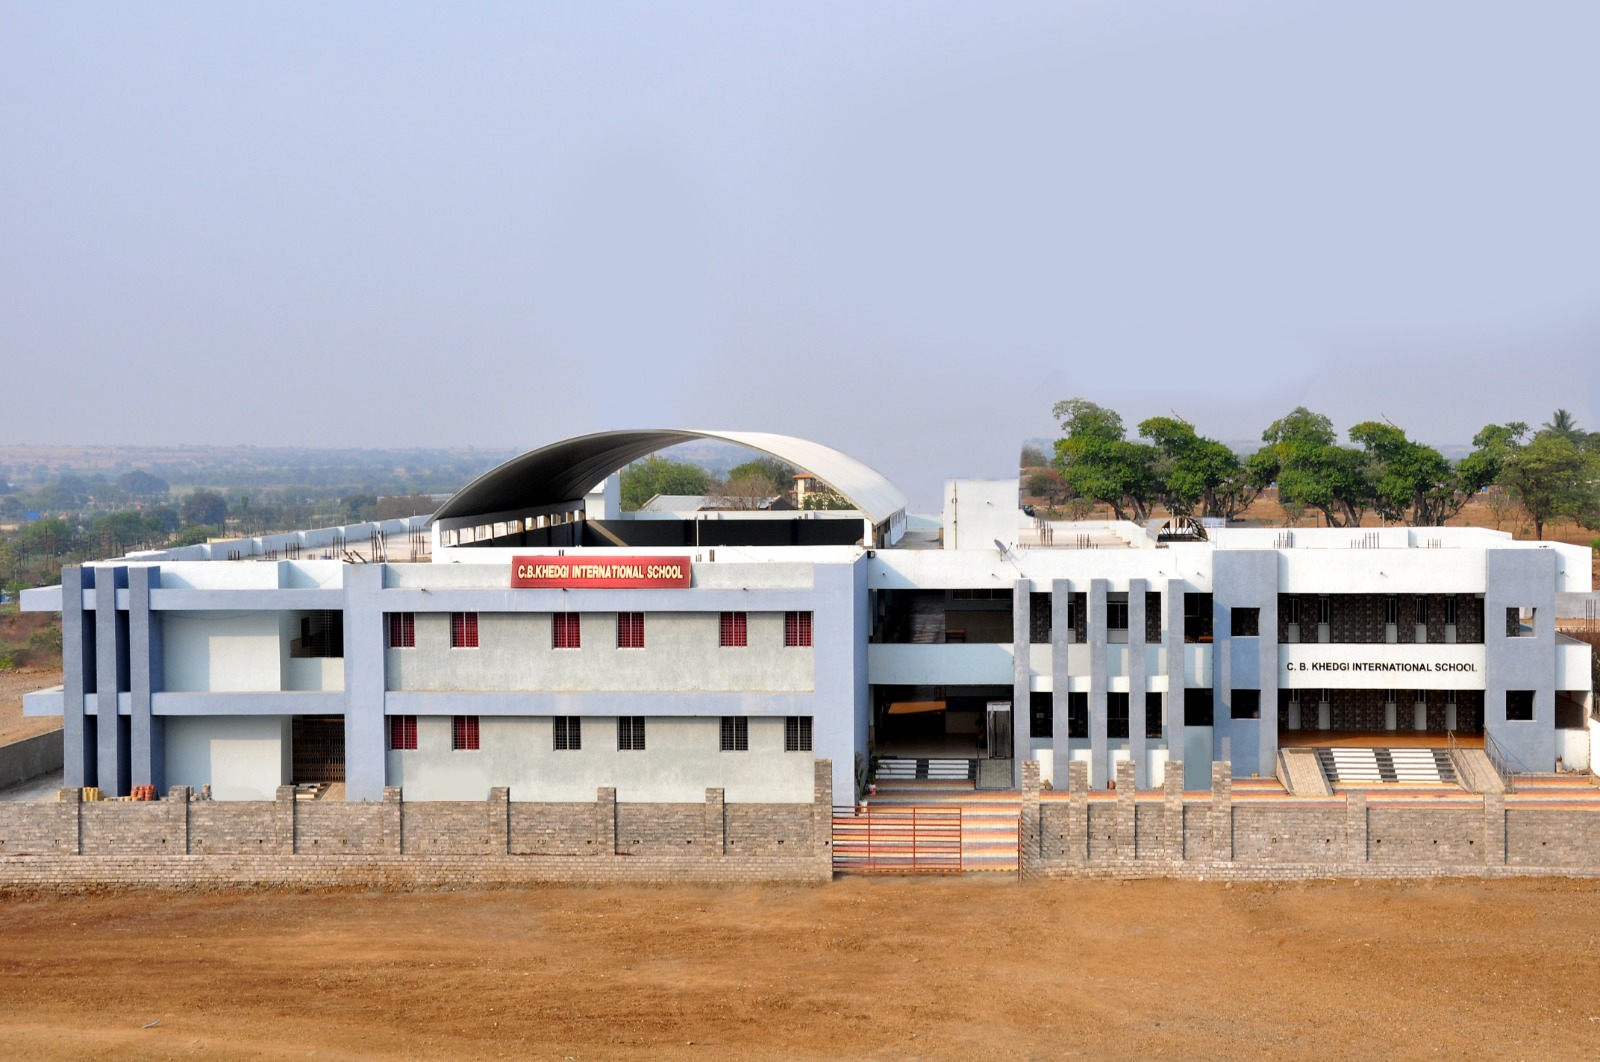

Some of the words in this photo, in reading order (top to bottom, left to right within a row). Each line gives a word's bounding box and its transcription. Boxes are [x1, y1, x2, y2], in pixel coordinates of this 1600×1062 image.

[517, 565, 569, 579] C.B.KHEDGI
[571, 565, 645, 579] INTERNATIONAL
[647, 565, 684, 579] SCHOOL
[1286, 662, 1297, 672] C.
[1299, 662, 1309, 672] B.
[1311, 662, 1350, 672] KHEDGI
[1352, 662, 1433, 672] INTERNATIONAL
[1434, 663, 1478, 672] SCHOOL
